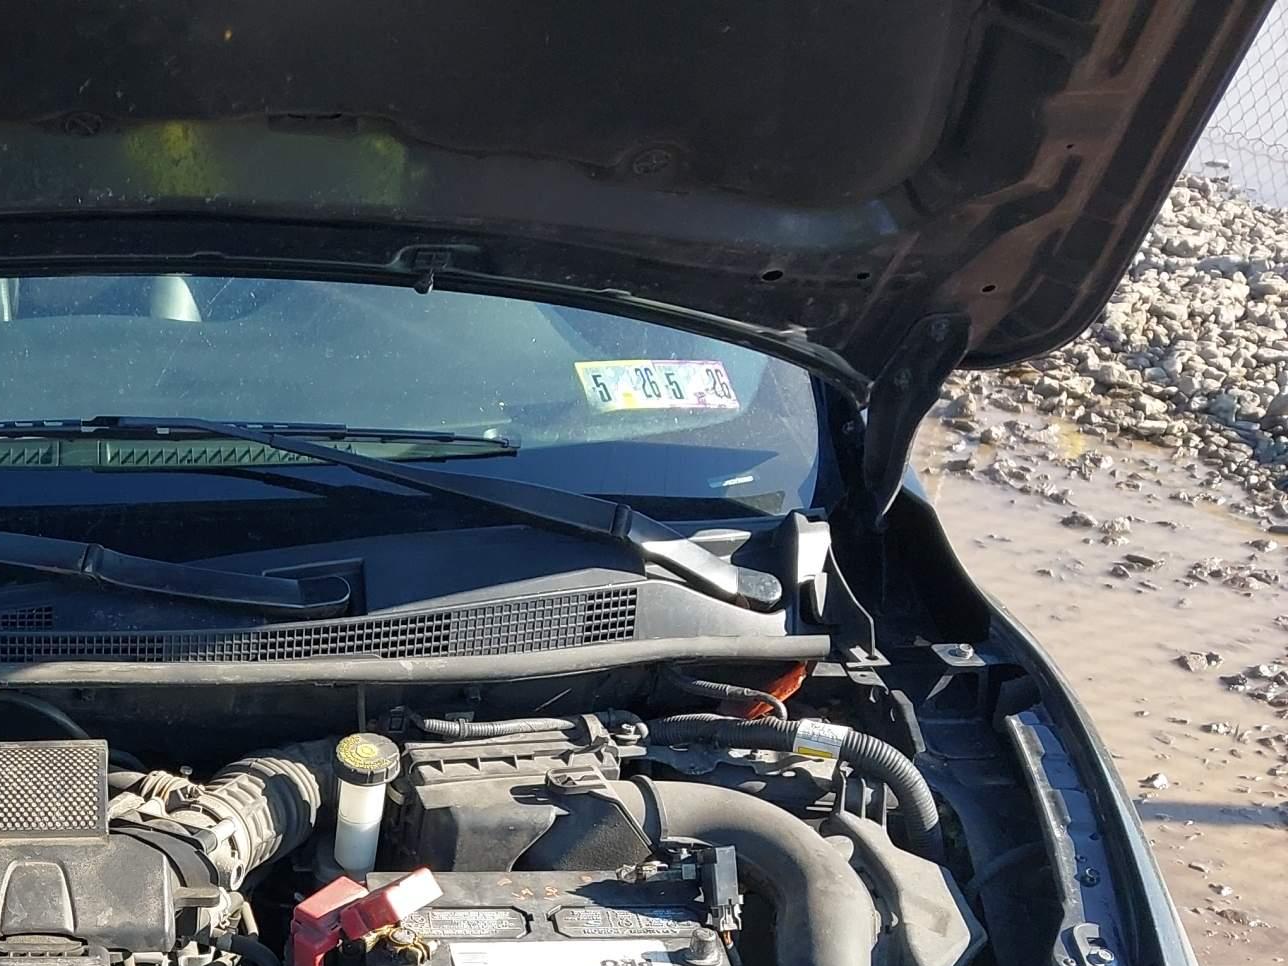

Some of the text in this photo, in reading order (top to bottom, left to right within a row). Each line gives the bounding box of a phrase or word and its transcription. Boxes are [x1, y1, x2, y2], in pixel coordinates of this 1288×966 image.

[592, 374, 612, 403] 5
[634, 367, 662, 399] 26
[665, 372, 685, 400] 5
[706, 368, 732, 399] 26
